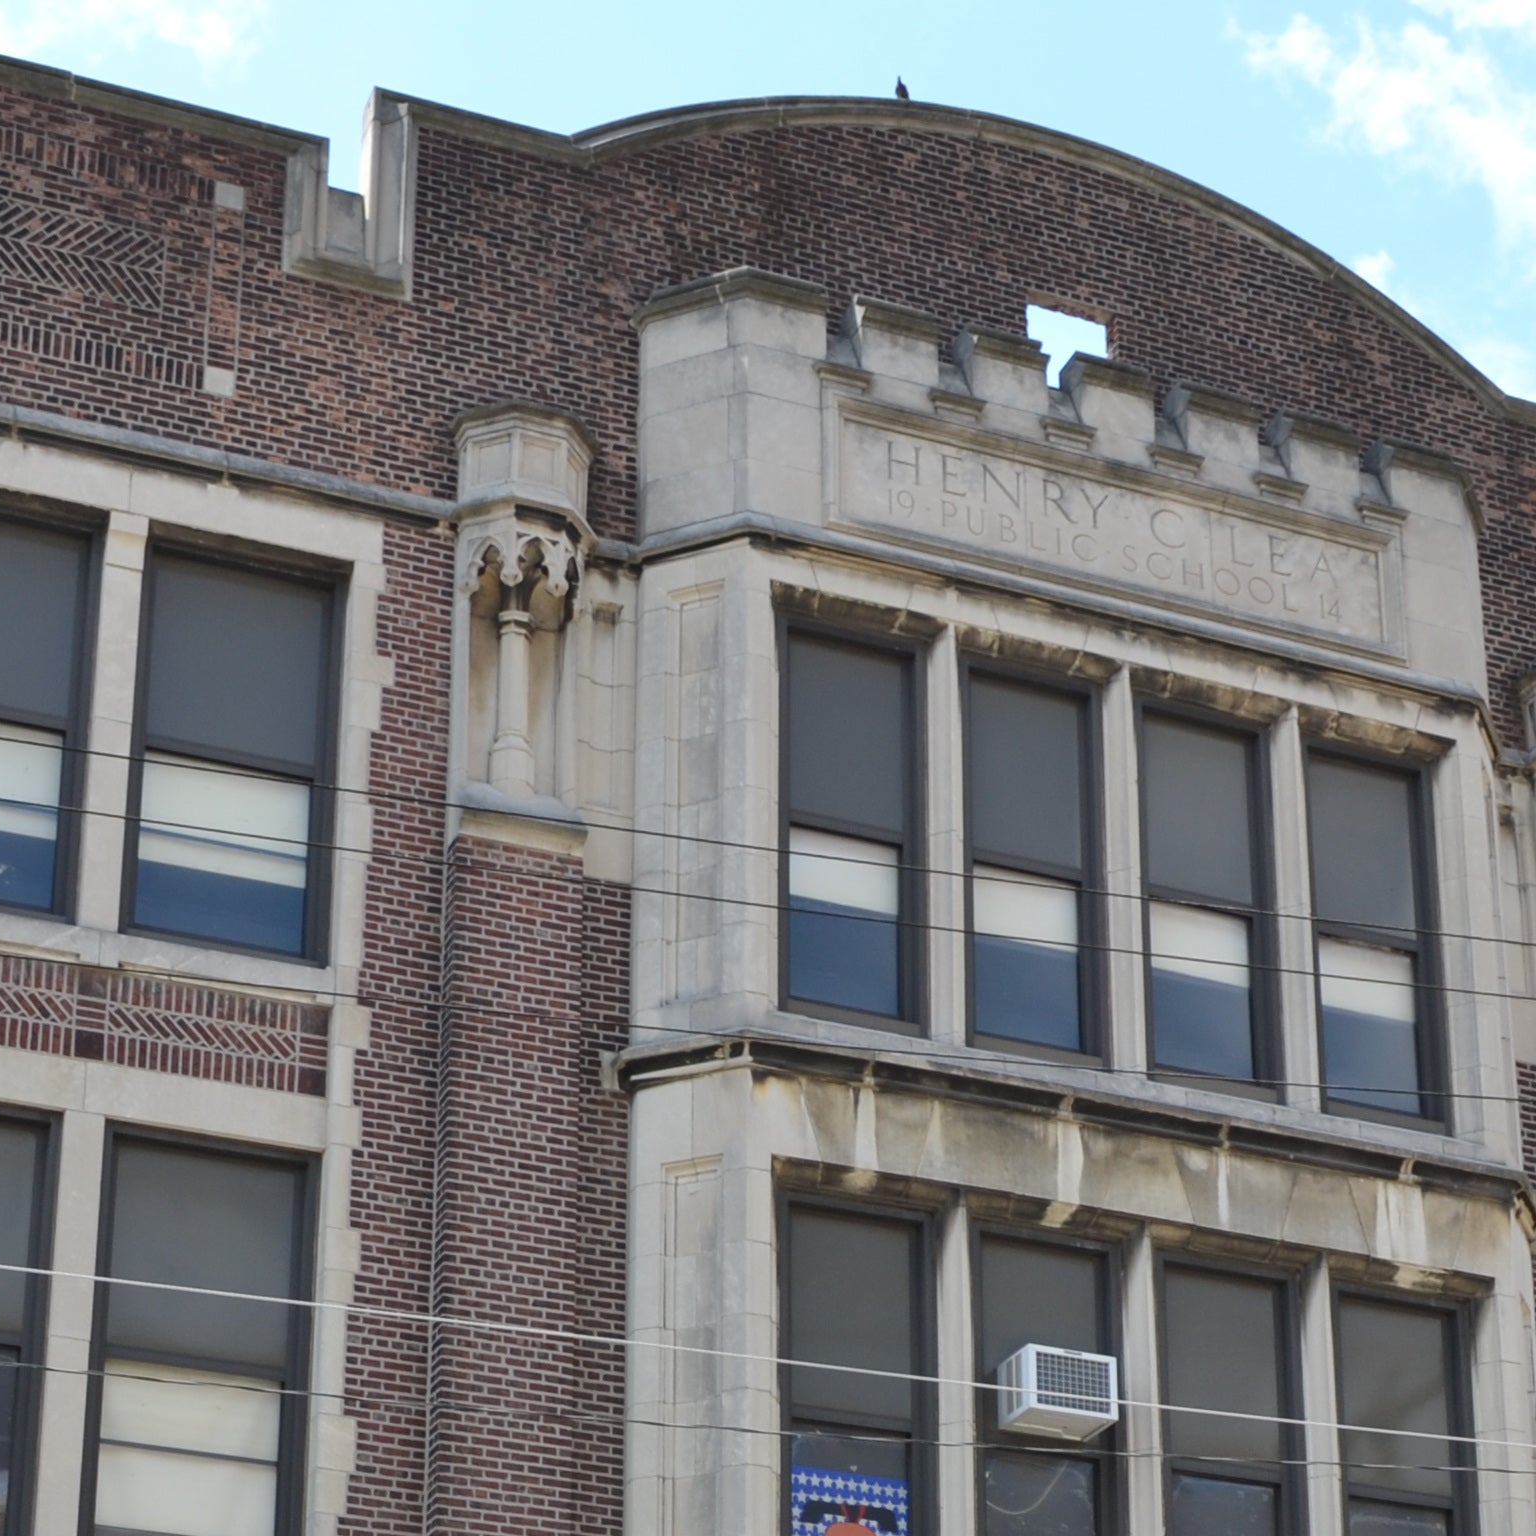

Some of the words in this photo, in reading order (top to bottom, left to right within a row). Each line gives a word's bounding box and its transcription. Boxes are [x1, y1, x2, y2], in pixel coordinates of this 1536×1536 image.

[886, 440, 1109, 530] HENRY
[1150, 508, 1186, 549] C
[1228, 525, 1339, 589] LEA
[887, 488, 915, 519] 19
[941, 499, 1098, 562] PUBLIC
[1121, 544, 1299, 613] SCHOOL
[1320, 594, 1342, 623] 14
